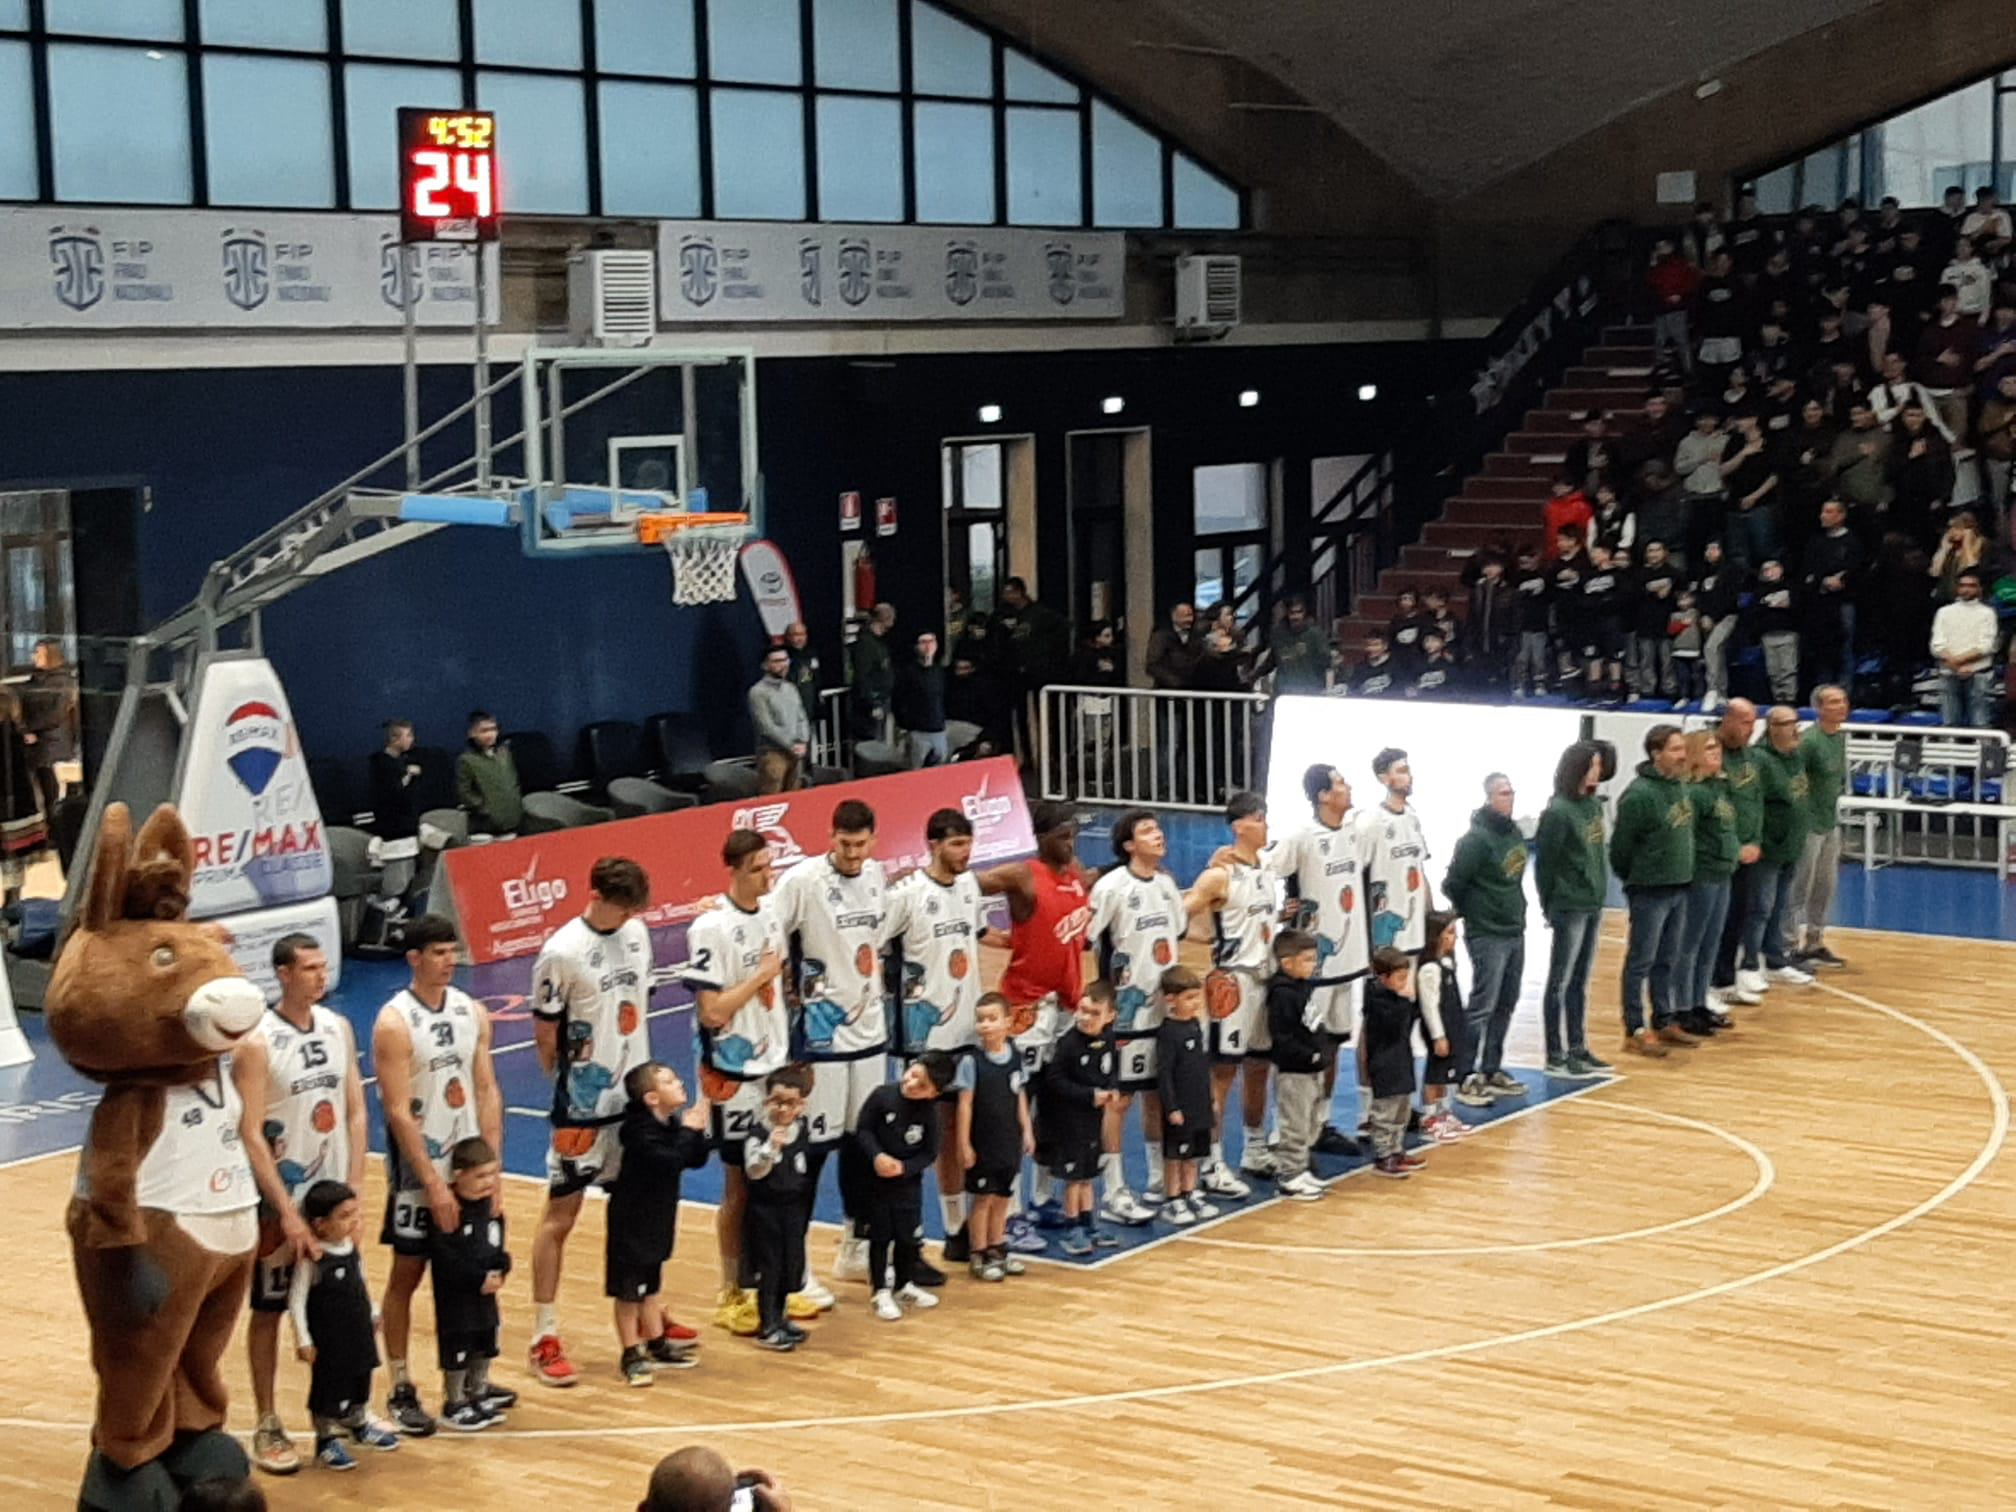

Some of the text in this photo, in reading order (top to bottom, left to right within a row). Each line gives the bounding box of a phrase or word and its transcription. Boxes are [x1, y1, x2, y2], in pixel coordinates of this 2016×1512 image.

[415, 152, 491, 217] 24
[192, 819, 321, 868] RE/MAX
[502, 878, 568, 910] Eligo
[1228, 1030, 1241, 1047] 4
[299, 1040, 328, 1069] 15
[1132, 1054, 1146, 1074] 6
